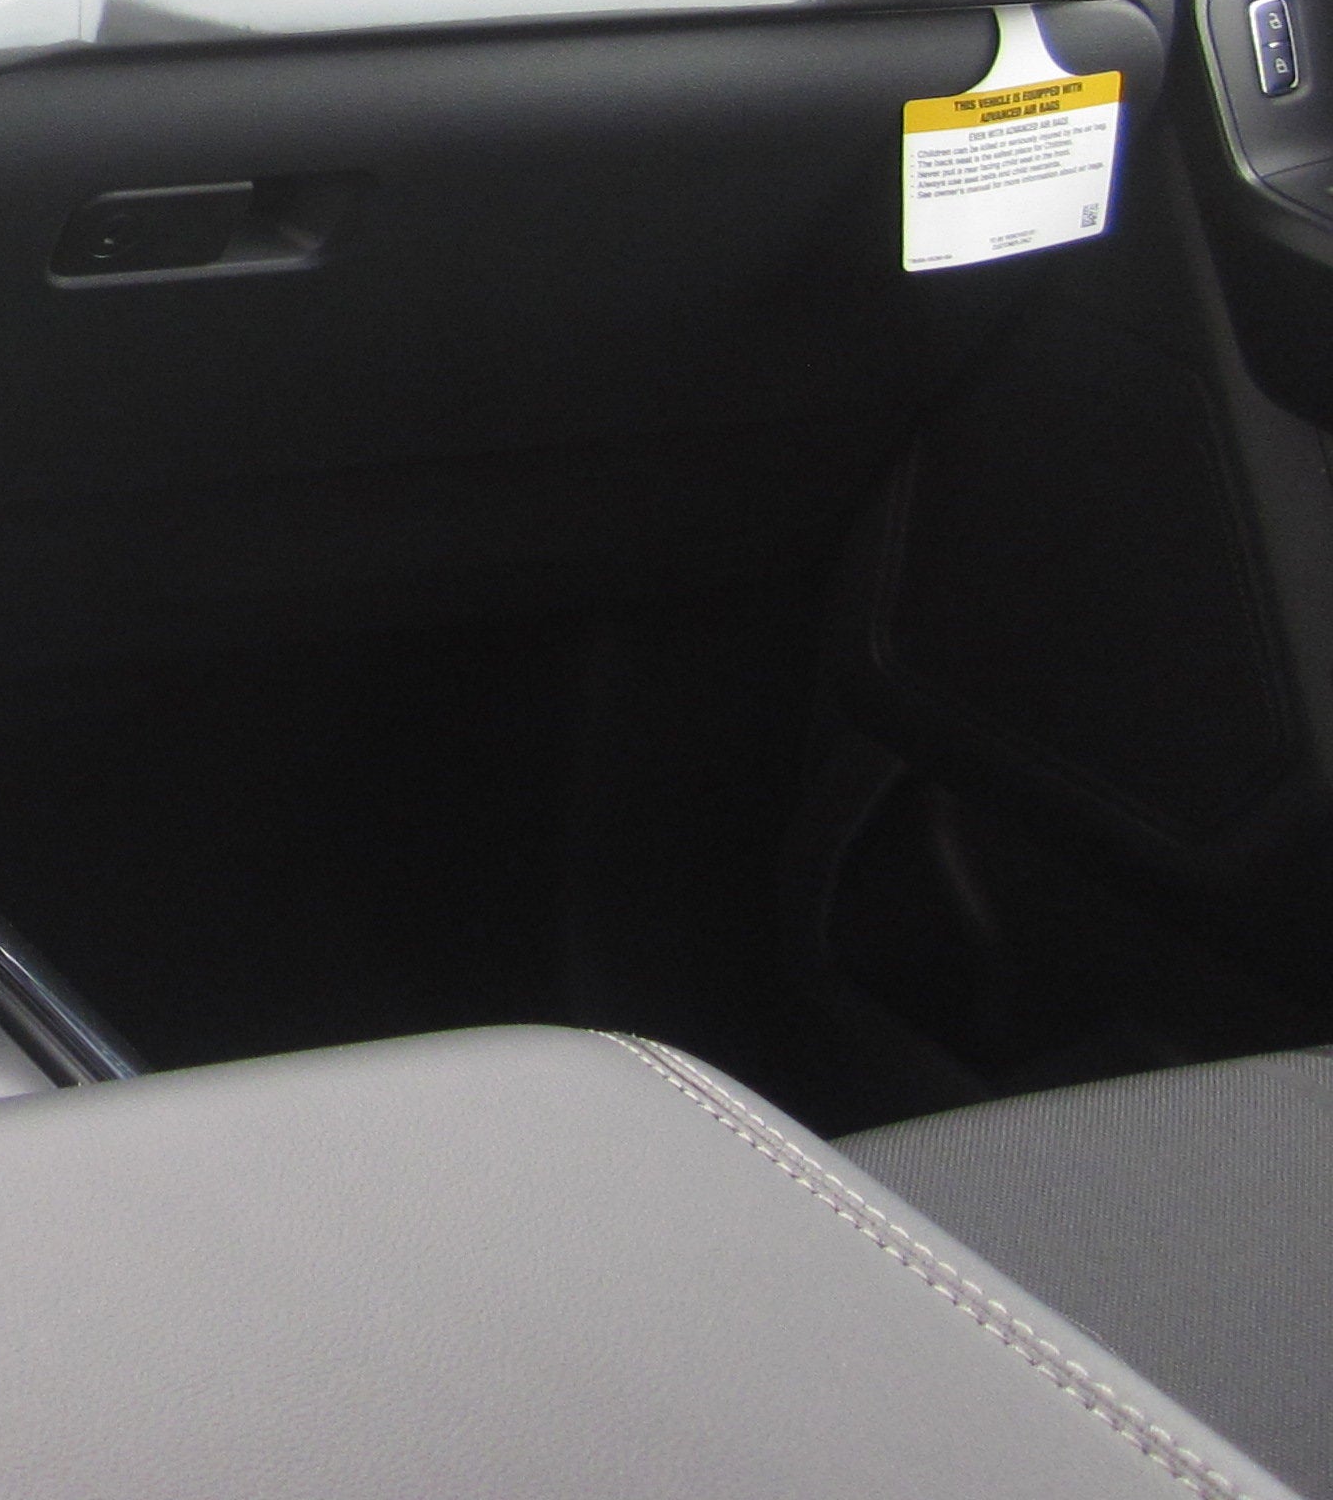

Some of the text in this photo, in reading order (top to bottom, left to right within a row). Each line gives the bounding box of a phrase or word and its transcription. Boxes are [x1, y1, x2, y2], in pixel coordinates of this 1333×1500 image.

[954, 99, 975, 111] THIS
[979, 93, 1010, 108] VEHICLE
[981, 106, 1022, 122] ADVANCED
